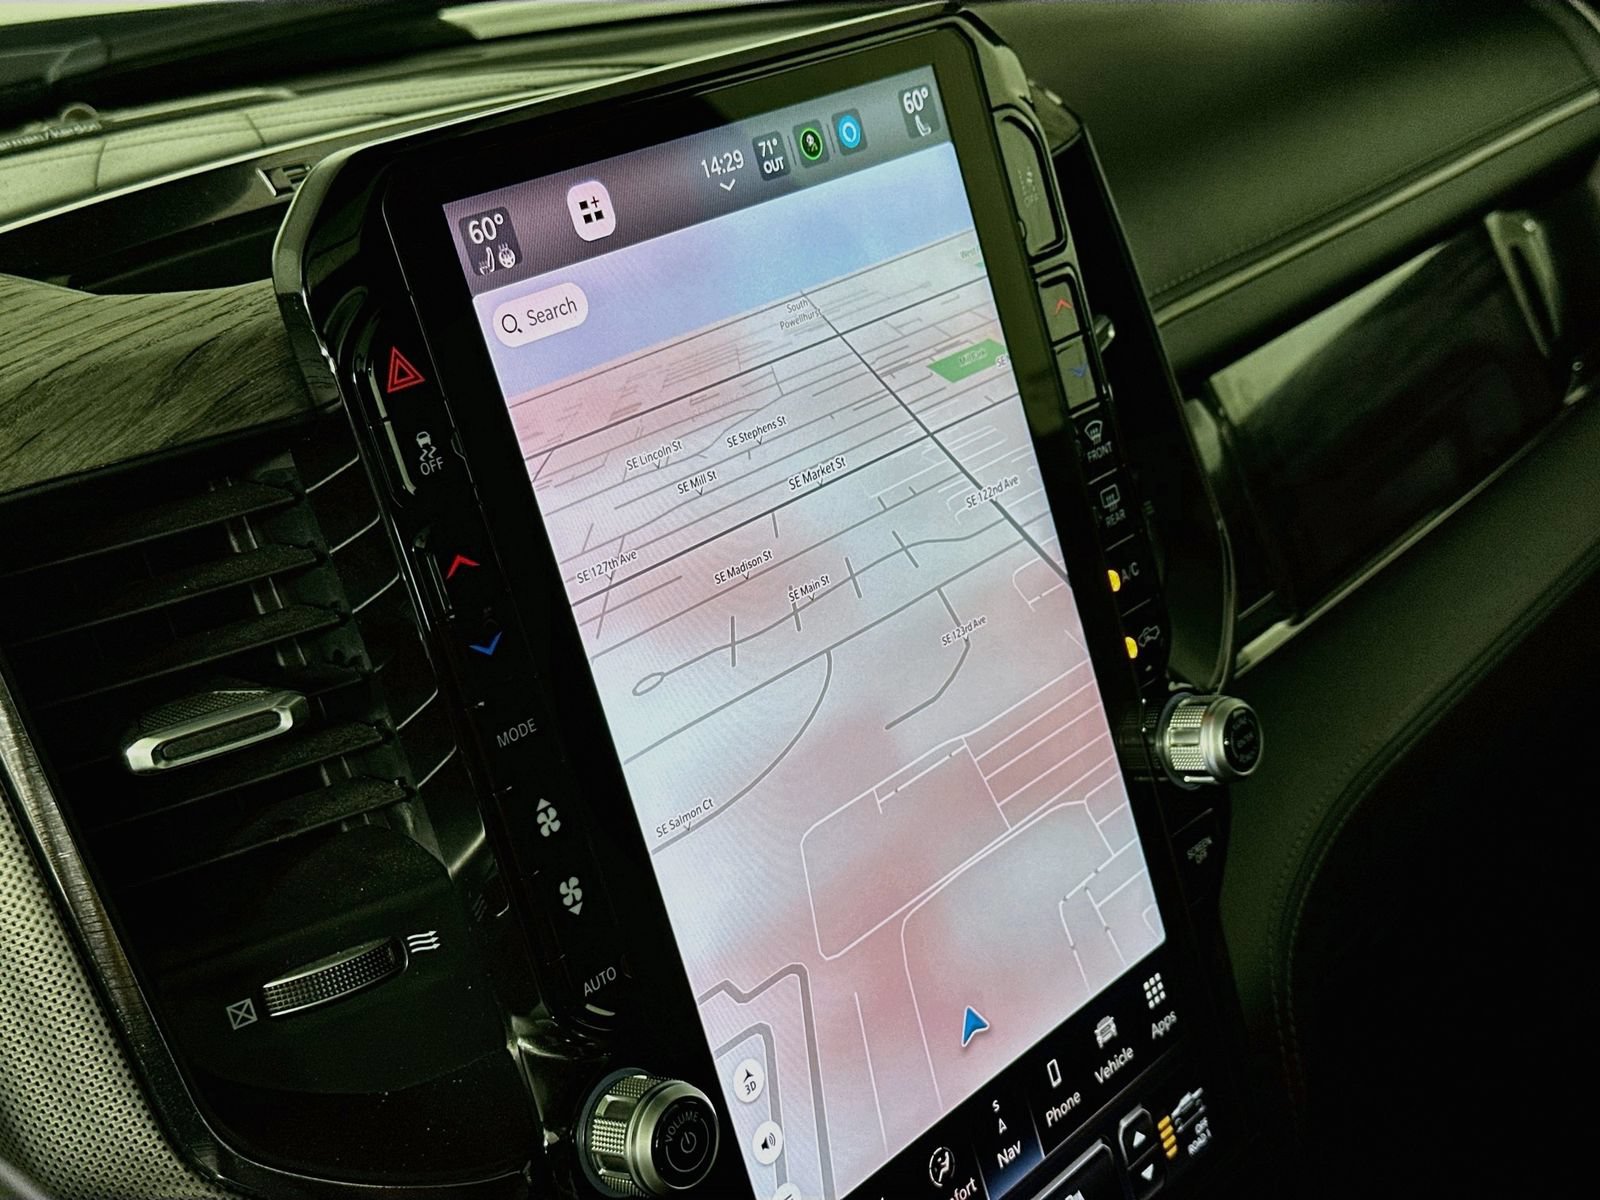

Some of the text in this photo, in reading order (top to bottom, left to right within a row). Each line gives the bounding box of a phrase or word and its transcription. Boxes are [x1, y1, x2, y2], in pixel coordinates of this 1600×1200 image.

[902, 86, 929, 115] 60°
[758, 137, 778, 159] 71°
[701, 149, 745, 179] 14:29
[763, 156, 785, 174] OUT
[468, 213, 504, 245] 60°
[526, 297, 578, 326] Search
[779, 308, 823, 331] Powellhurst
[786, 299, 809, 313] South
[727, 415, 788, 449] SE Stephens St
[420, 457, 444, 476] OFF
[626, 440, 683, 472] SE Lincoln St
[1087, 441, 1113, 463] FRONT
[677, 470, 718, 495] SE Mill St
[788, 457, 847, 491] SE Market St
[966, 476, 1020, 509] SE 122nd Ave
[1105, 508, 1126, 528] REAR
[576, 550, 639, 584] SE 127th Ave
[714, 549, 774, 585] SE Madison St
[1121, 562, 1140, 582] A/C
[788, 575, 831, 603] SE Main St
[941, 615, 988, 647] SE 123rd Ave
[496, 718, 537, 748] MODE
[656, 798, 715, 838] SE Salmon Ct
[583, 966, 618, 997] AUTO
[1151, 1010, 1177, 1040] Apps
[1094, 1045, 1135, 1084] Vehicle
[745, 1080, 757, 1096] 3D
[1045, 1090, 1082, 1128] Phone
[665, 1110, 700, 1144] VOLUME
[997, 1140, 1022, 1169] Nav
[950, 1176, 978, 1200] fort
